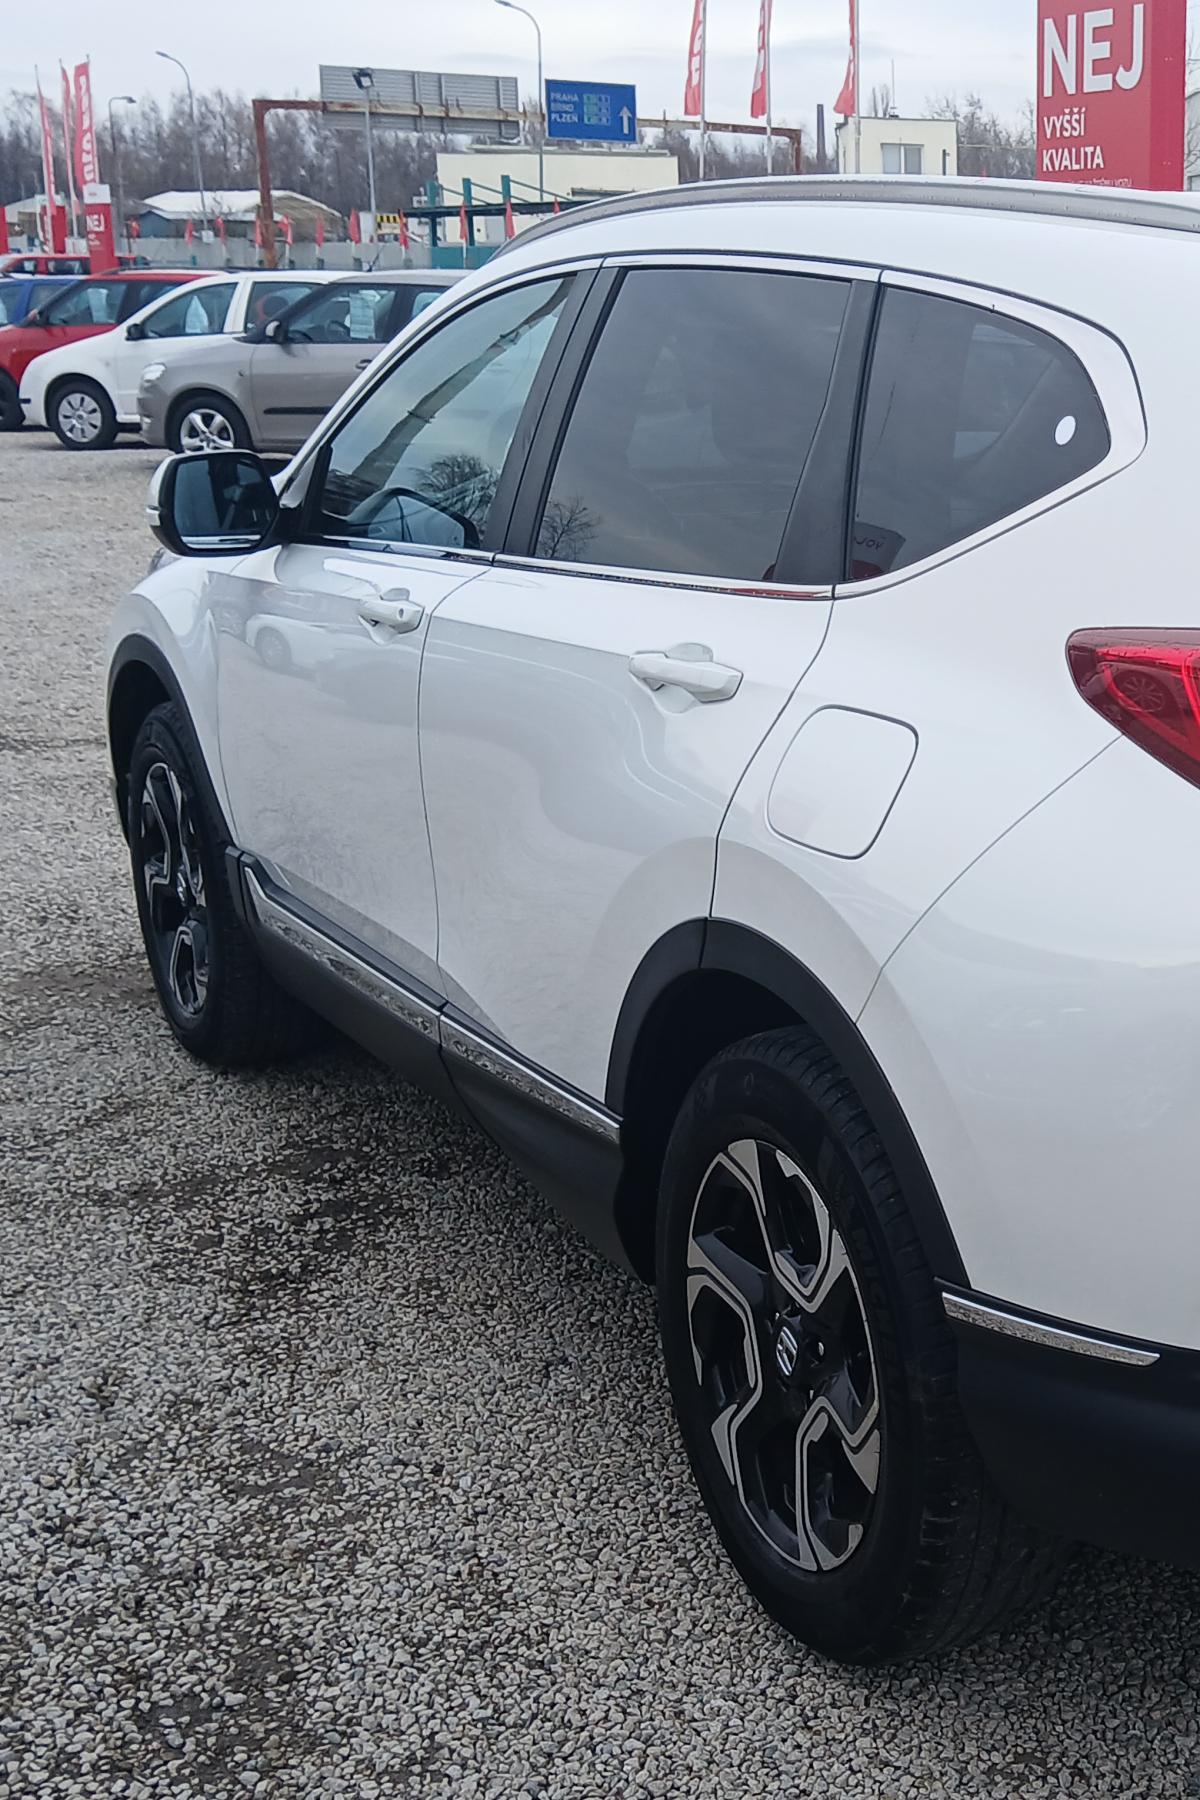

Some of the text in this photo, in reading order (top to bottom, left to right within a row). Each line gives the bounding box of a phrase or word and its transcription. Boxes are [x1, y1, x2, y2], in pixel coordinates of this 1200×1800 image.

[1043, 3, 1145, 98] NEJ
[1043, 107, 1086, 139] VYŠŠÍ
[1042, 146, 1105, 172] KVALITA
